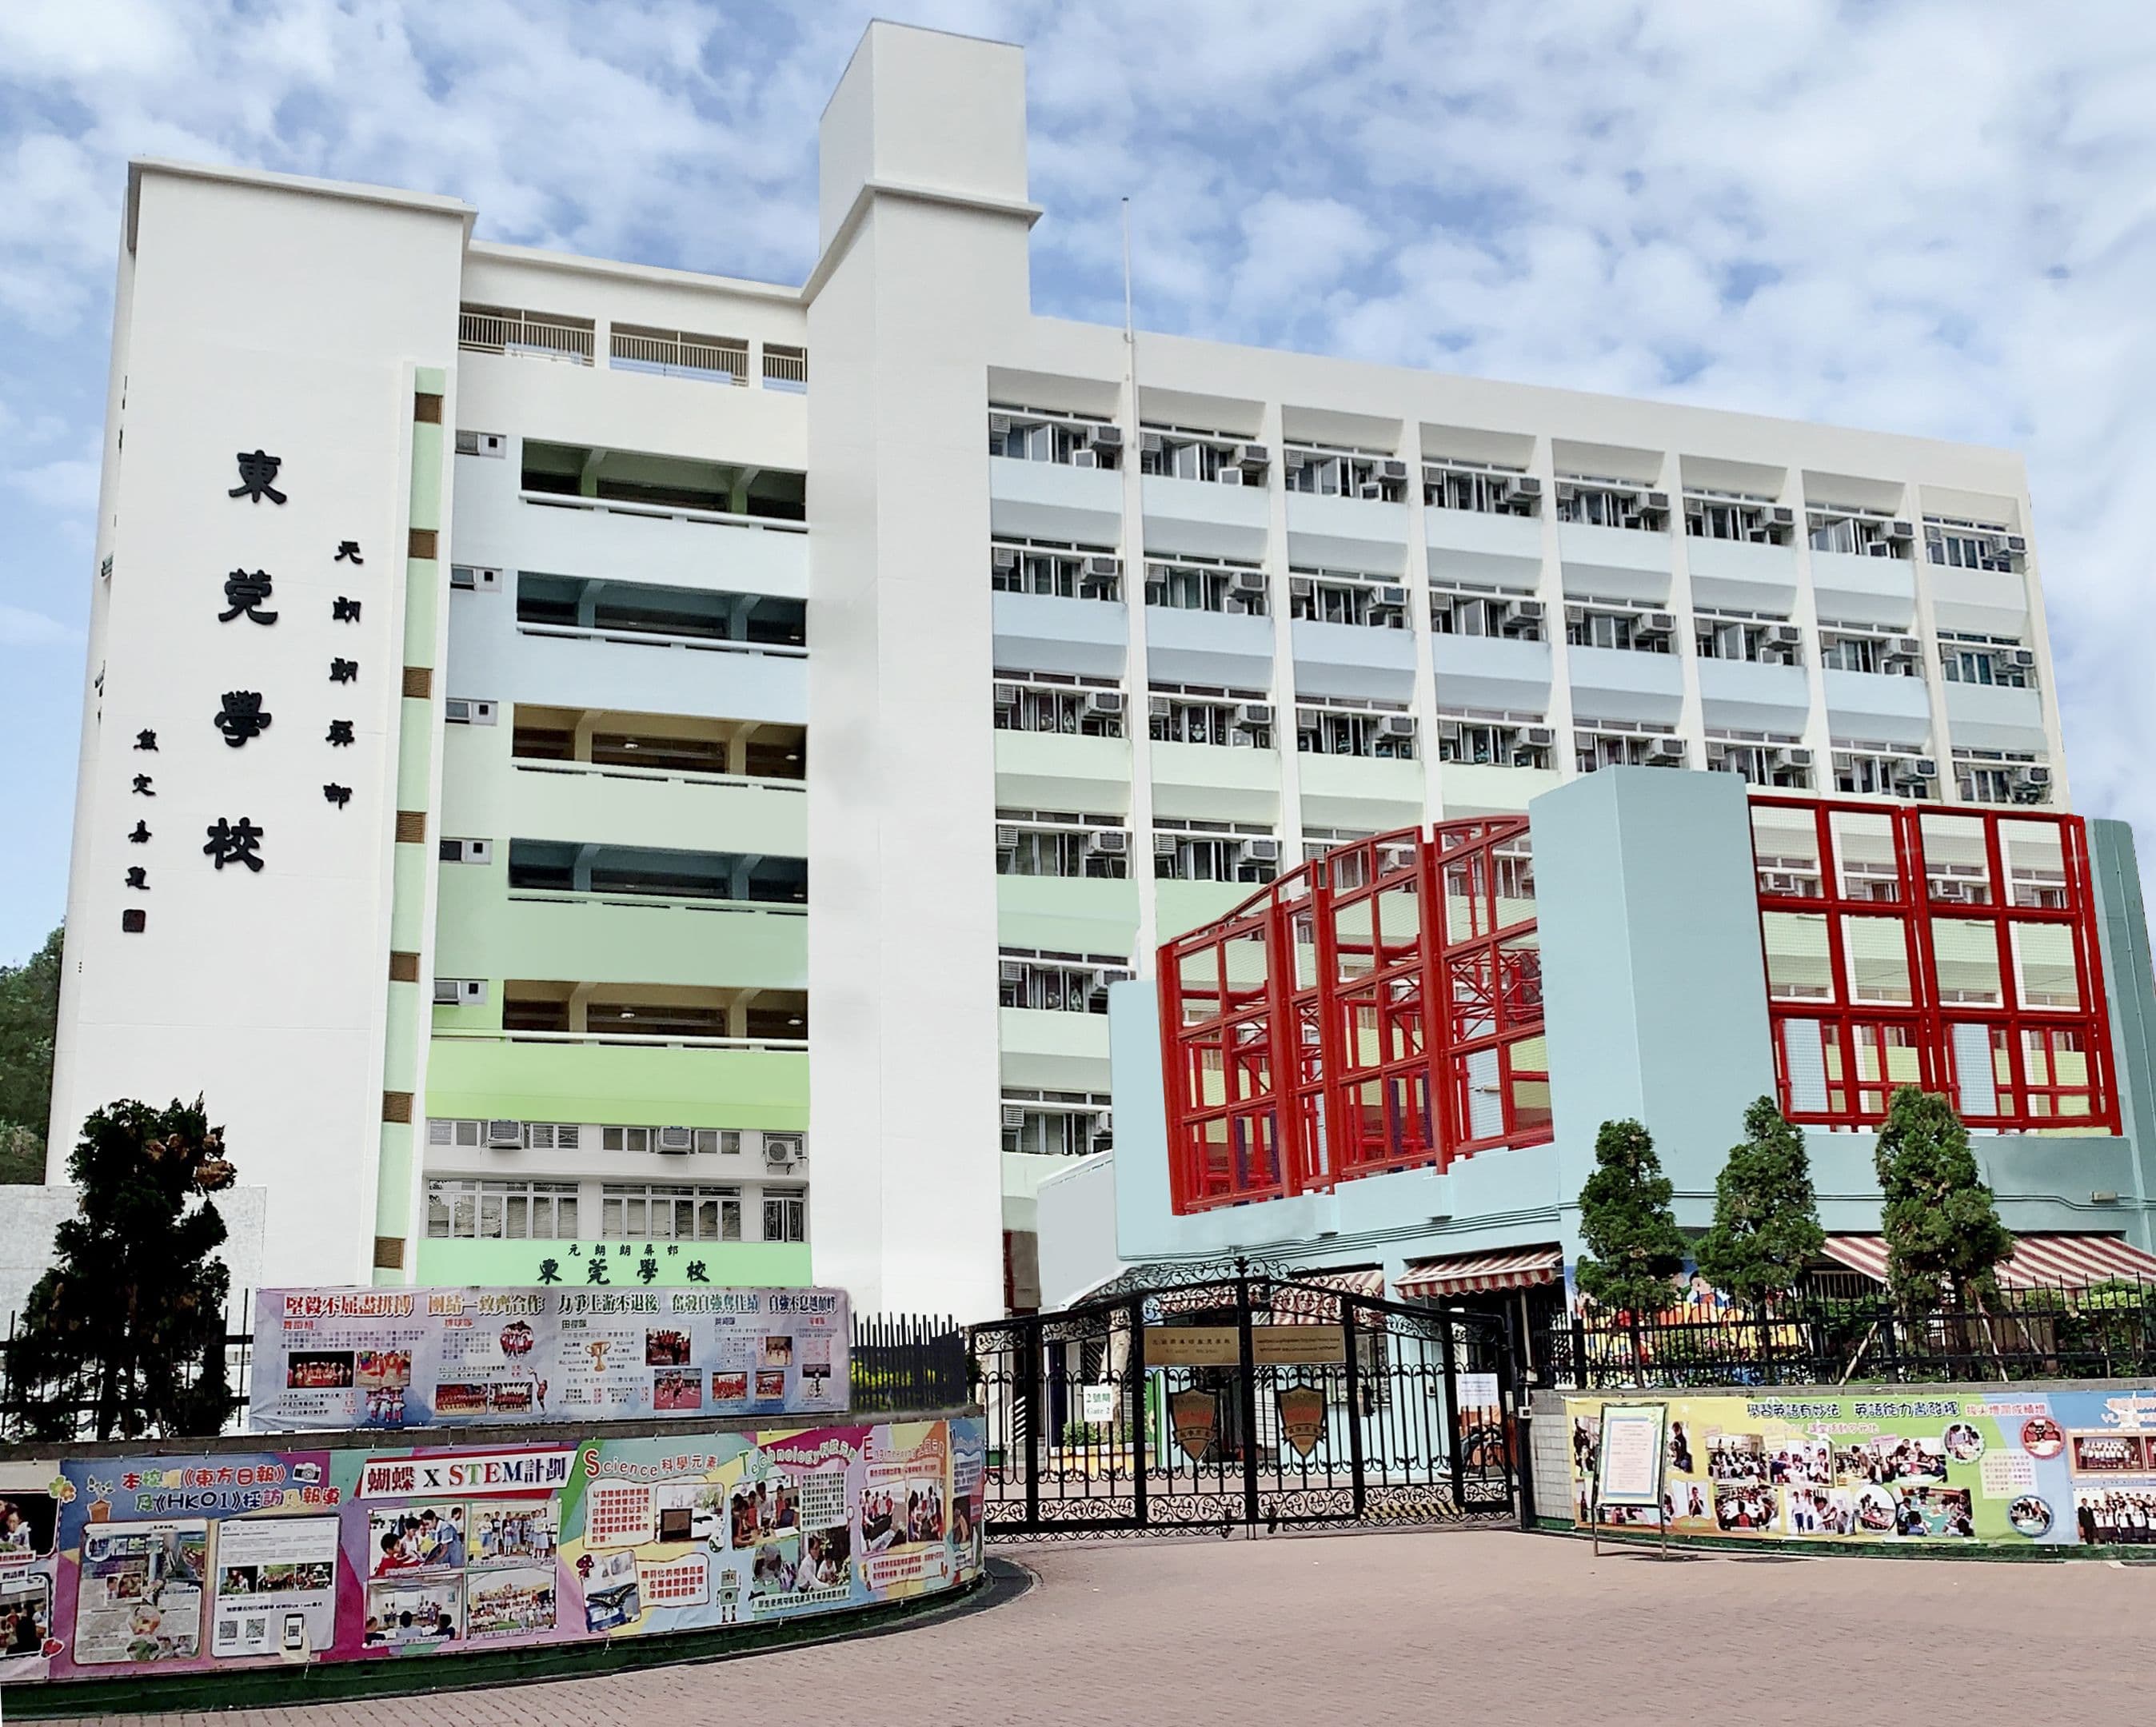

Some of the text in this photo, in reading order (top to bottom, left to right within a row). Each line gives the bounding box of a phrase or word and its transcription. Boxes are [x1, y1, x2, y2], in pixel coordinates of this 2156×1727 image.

[203, 449, 287, 872] 東莞學校
[568, 1243, 679, 1257] 元朗朗屏邨
[537, 1258, 710, 1285] 東莞學校
[585, 1449, 658, 1477] Science
[368, 1465, 416, 1493] 蝴蝶
